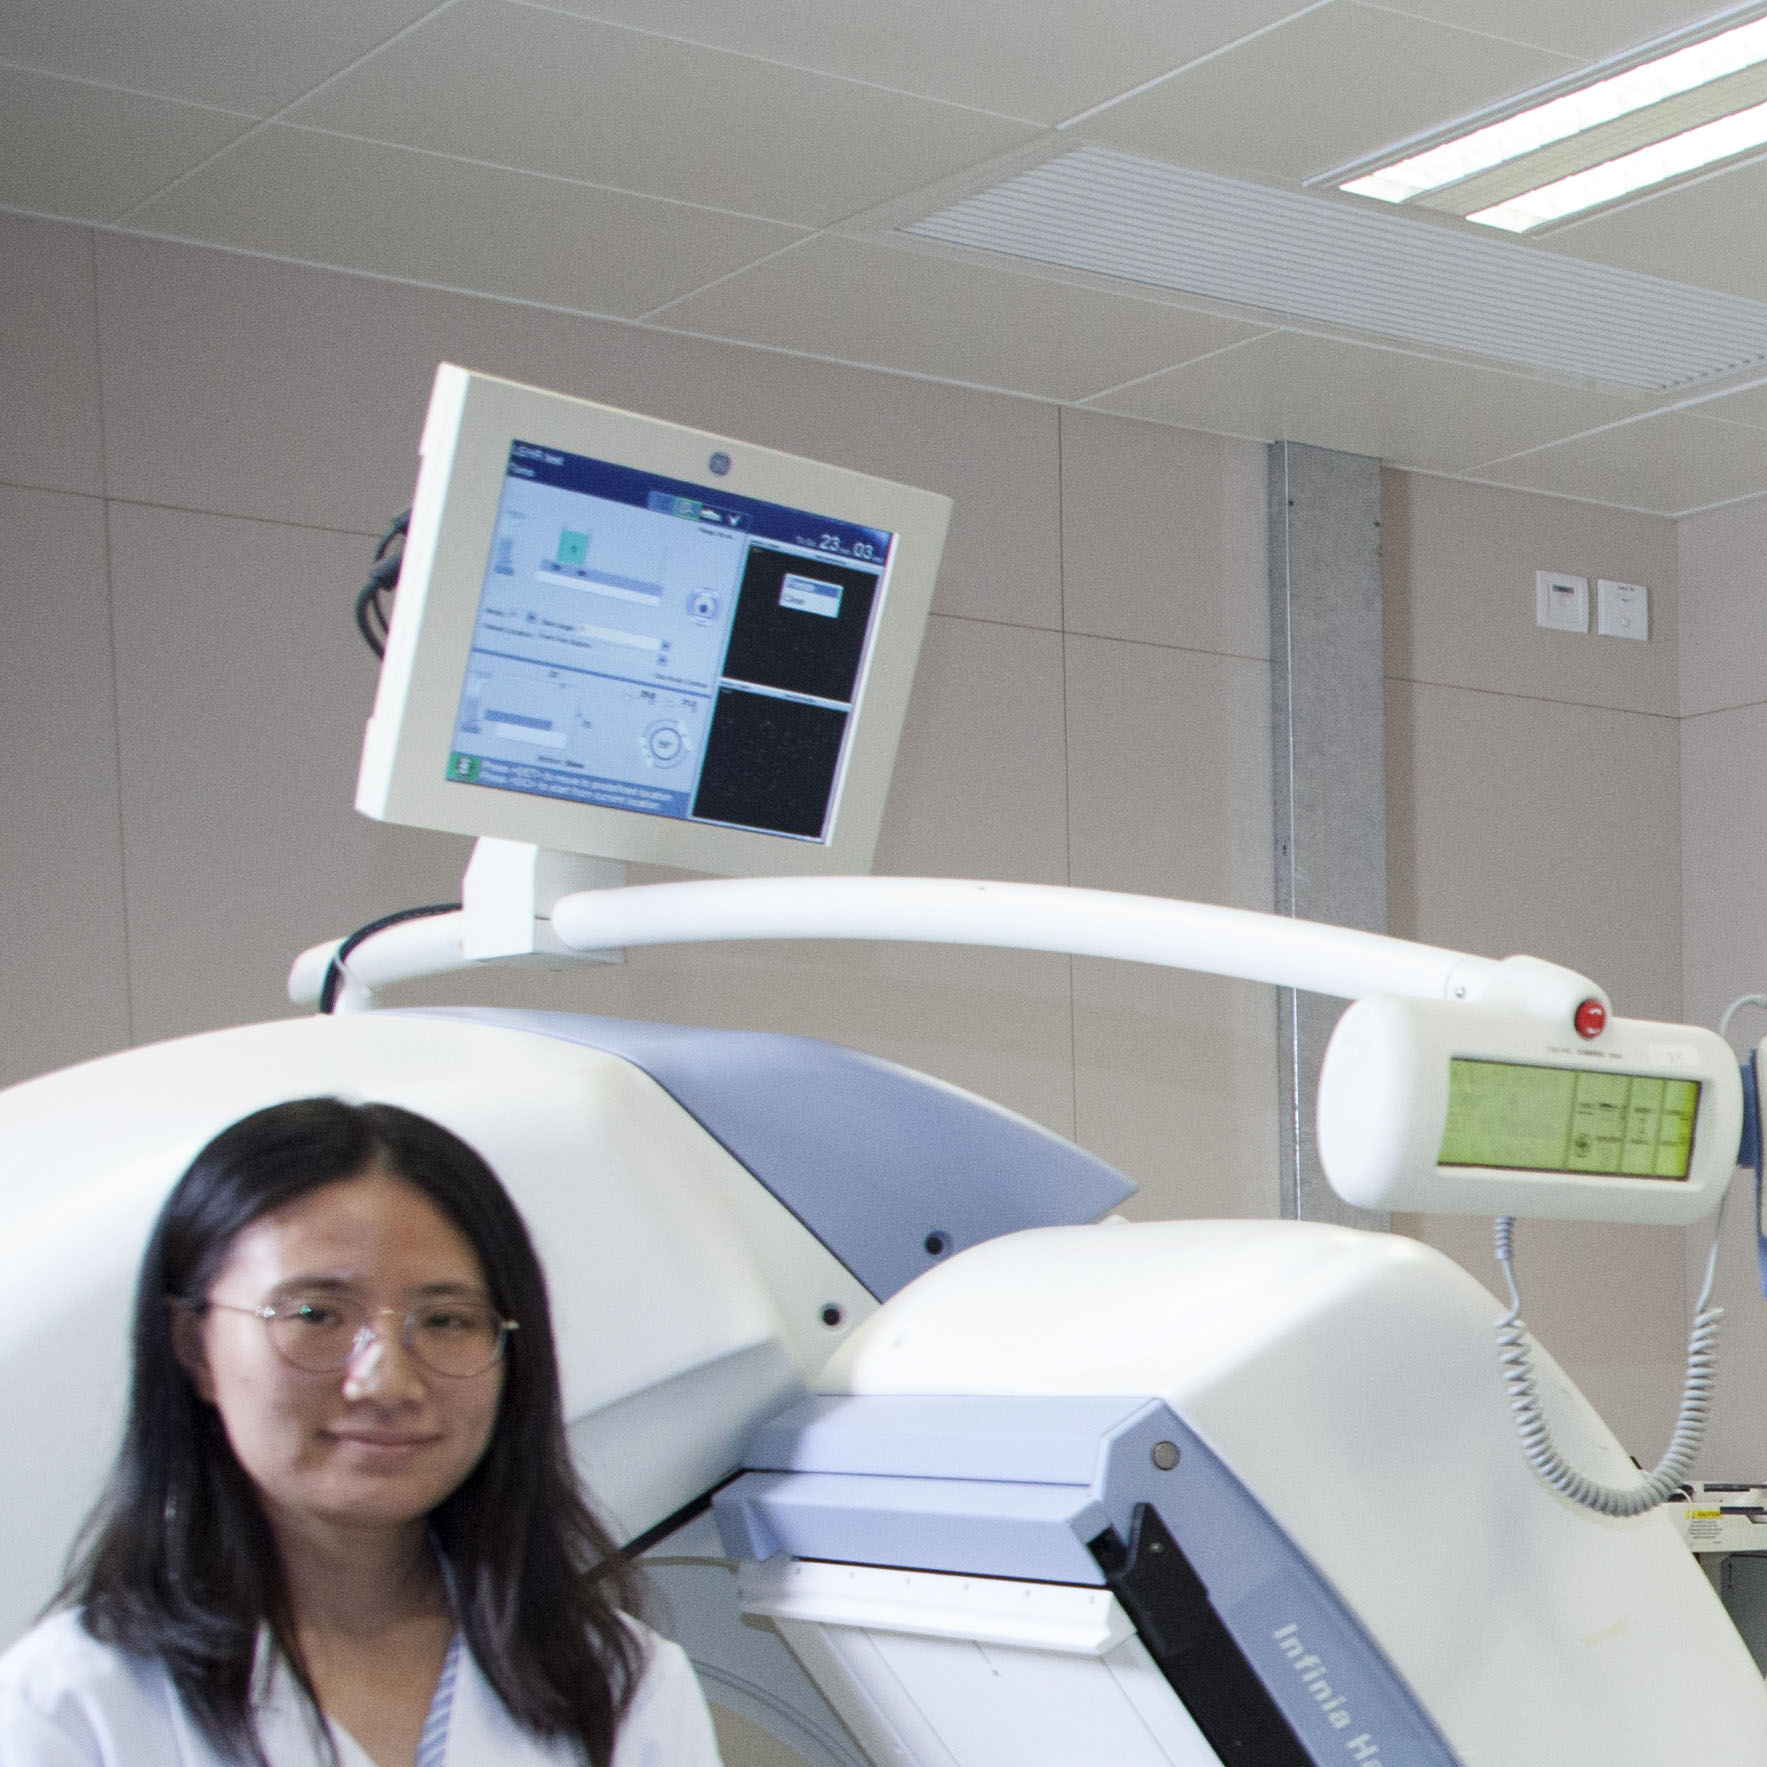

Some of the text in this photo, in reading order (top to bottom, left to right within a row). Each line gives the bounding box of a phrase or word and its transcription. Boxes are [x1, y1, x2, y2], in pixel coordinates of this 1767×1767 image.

[818, 534, 842, 552] 23
[852, 542, 874, 560] 03
[1275, 1624, 1351, 1730] Infinia
